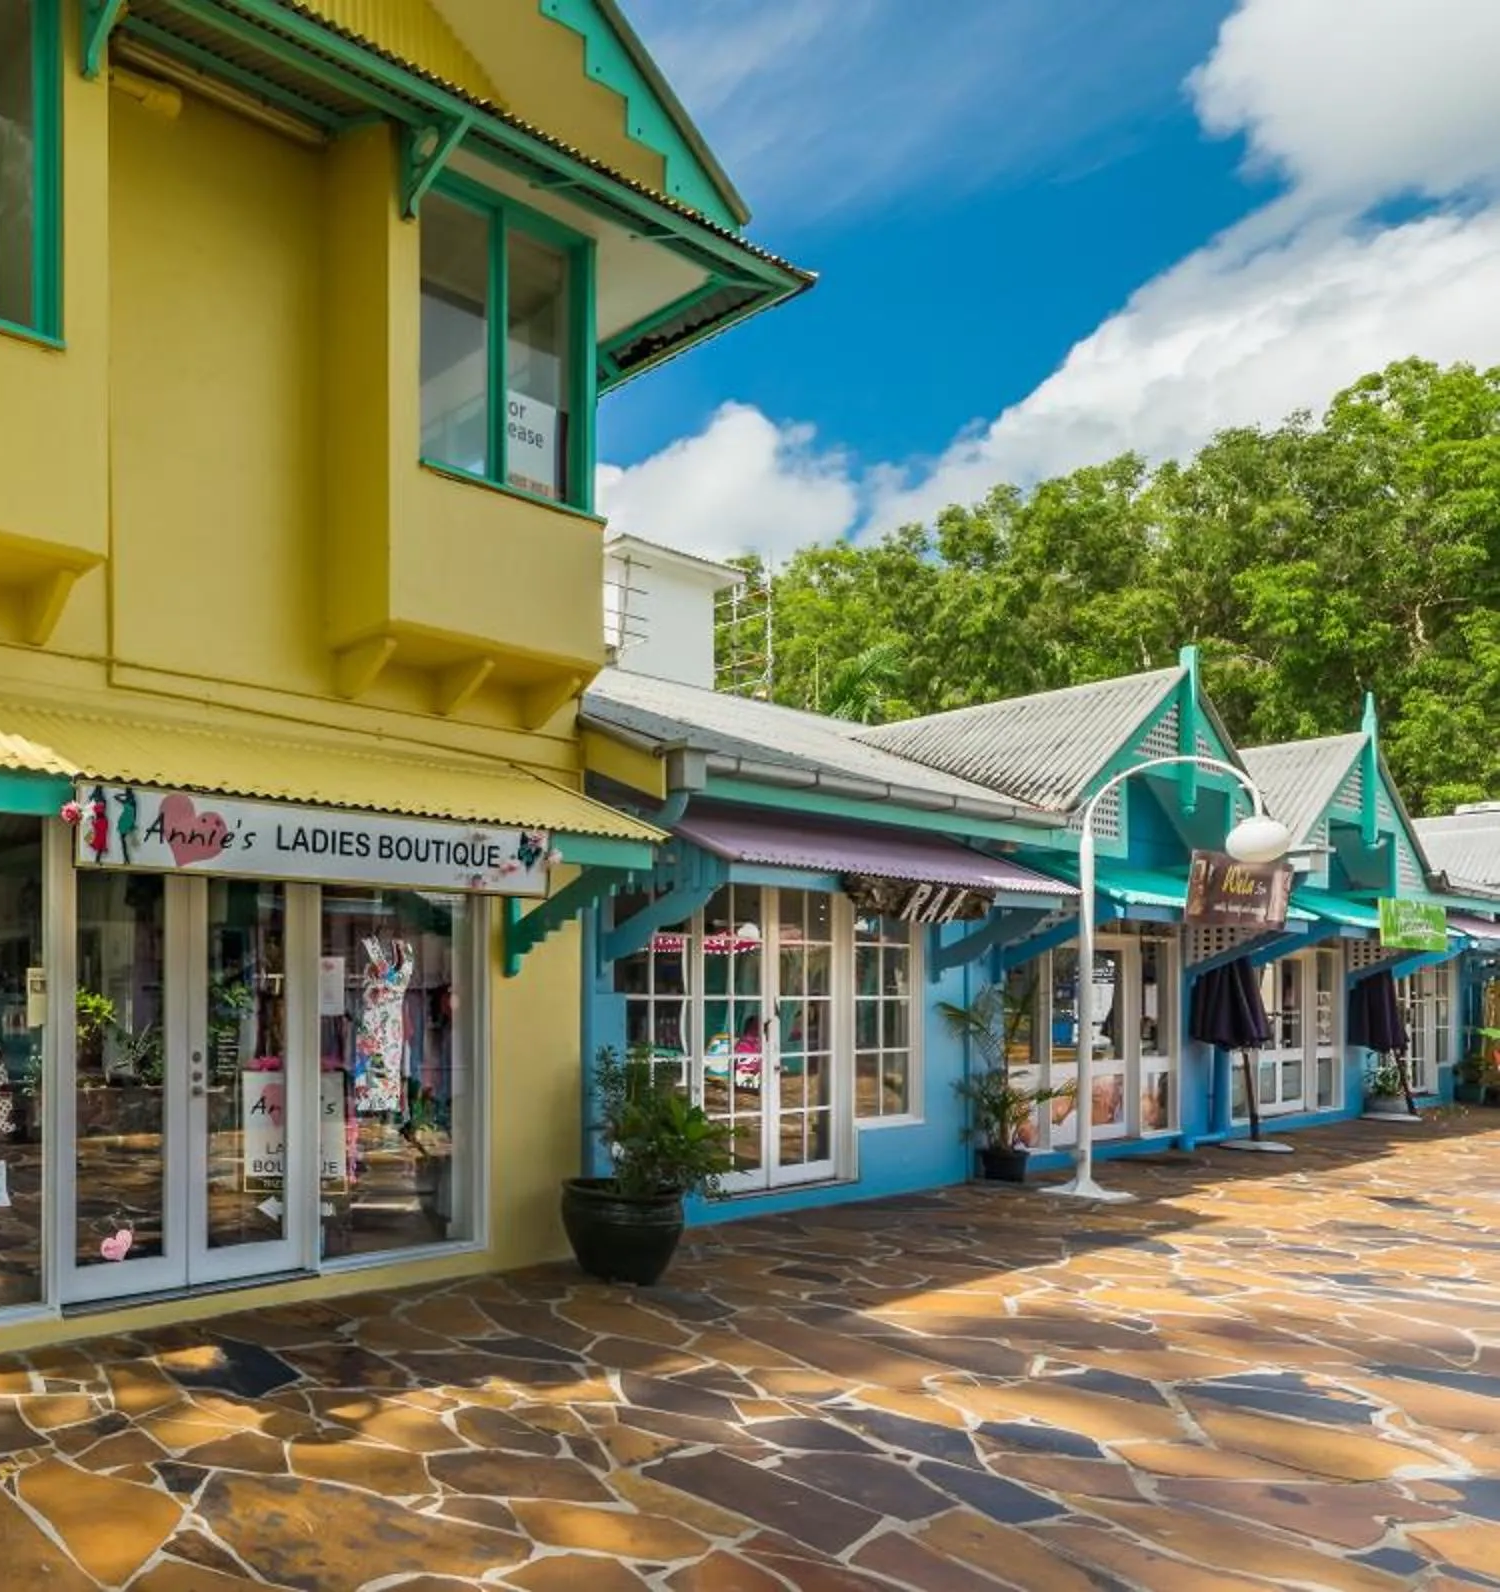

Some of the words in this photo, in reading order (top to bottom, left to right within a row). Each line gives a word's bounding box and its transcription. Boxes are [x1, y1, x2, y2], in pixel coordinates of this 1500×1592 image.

[508, 401, 526, 419] or
[508, 422, 544, 449] ease
[143, 811, 257, 851] Annie's
[276, 824, 371, 858] LADIES
[378, 833, 500, 869] BOUTIQUE
[251, 1095, 336, 1116] An's
